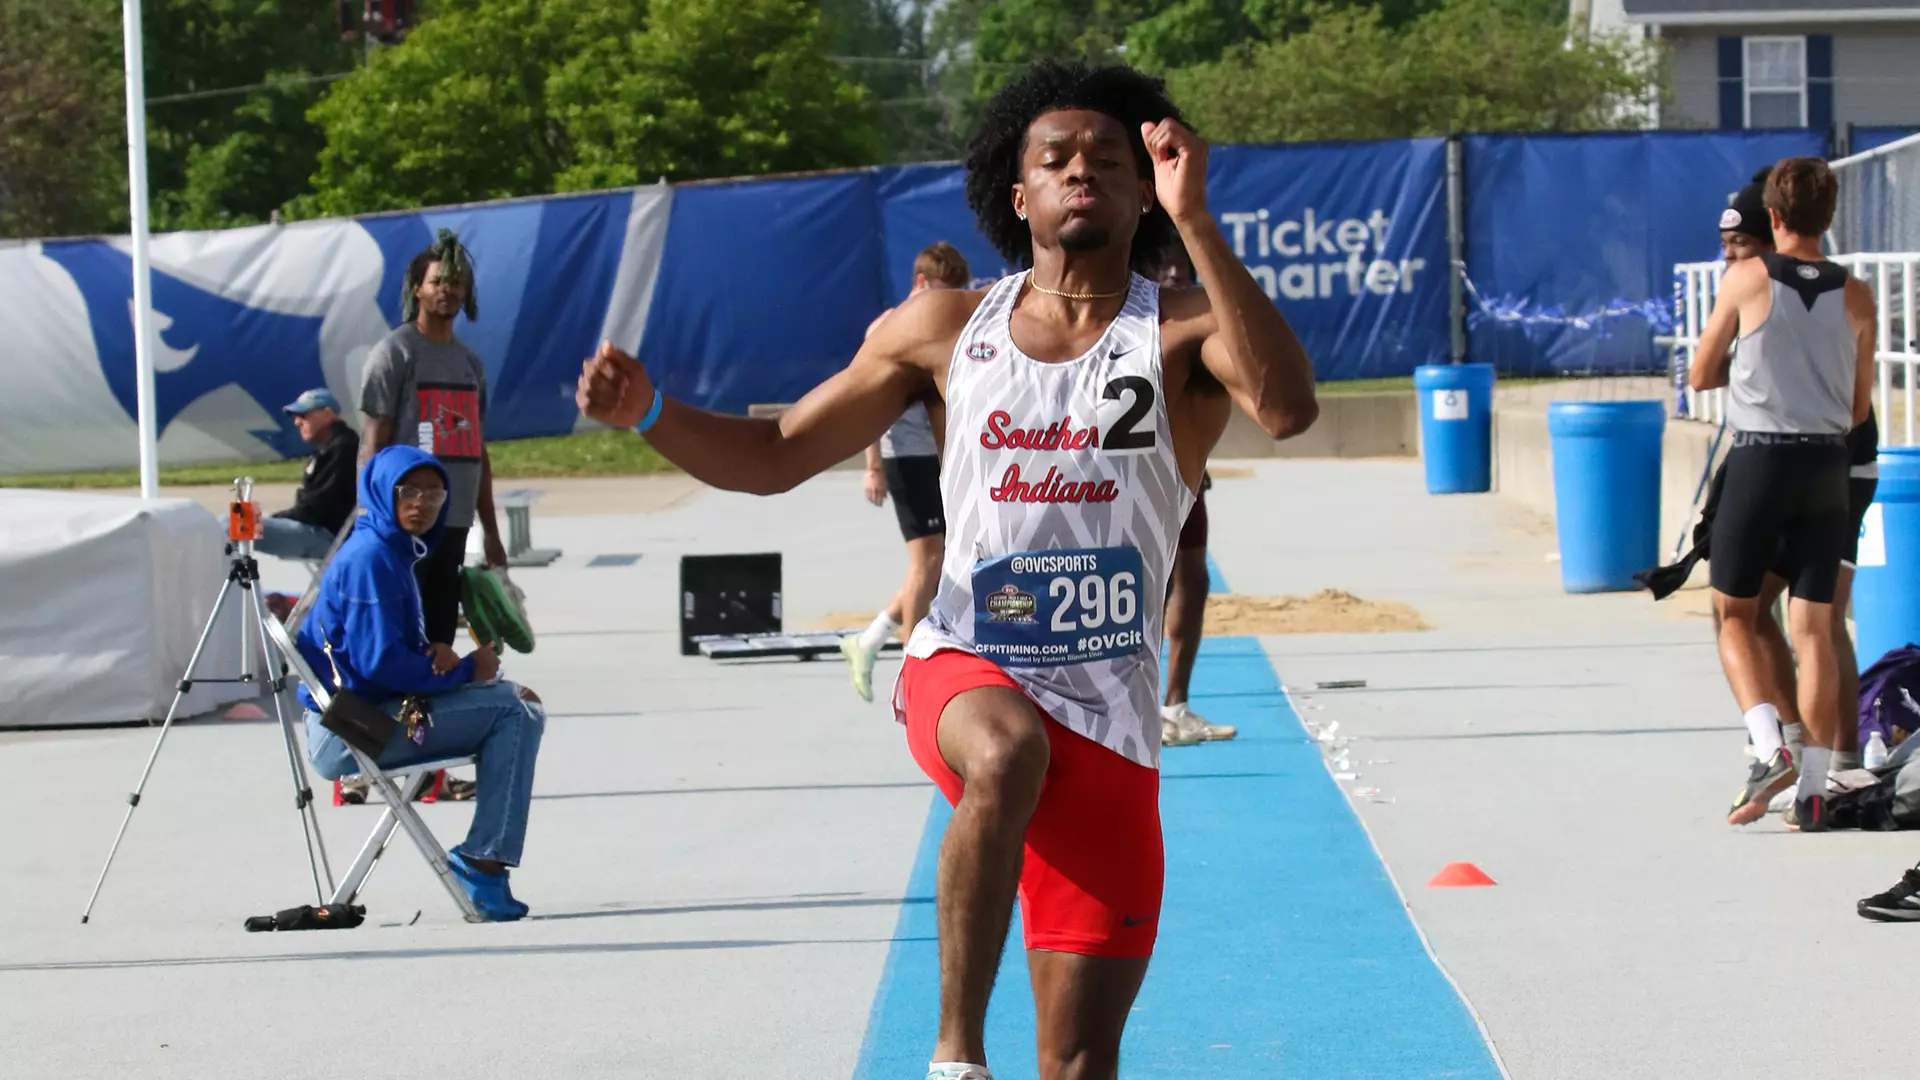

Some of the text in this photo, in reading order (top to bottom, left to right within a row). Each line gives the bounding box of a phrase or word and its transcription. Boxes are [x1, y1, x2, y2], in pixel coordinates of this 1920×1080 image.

[1221, 208, 1389, 257] Ticket
[980, 410, 1100, 450] Souther
[1102, 376, 1156, 450] 2
[990, 463, 1119, 503] Indiana
[1011, 555, 1097, 574] @OVCSPORTS
[1049, 571, 1136, 633] 296
[975, 629, 1142, 655] CFPITIMING.COM #OVCit
[1009, 655, 1032, 663] Hosted
[1033, 656, 1040, 664] by
[1042, 654, 1066, 663] Eastern
